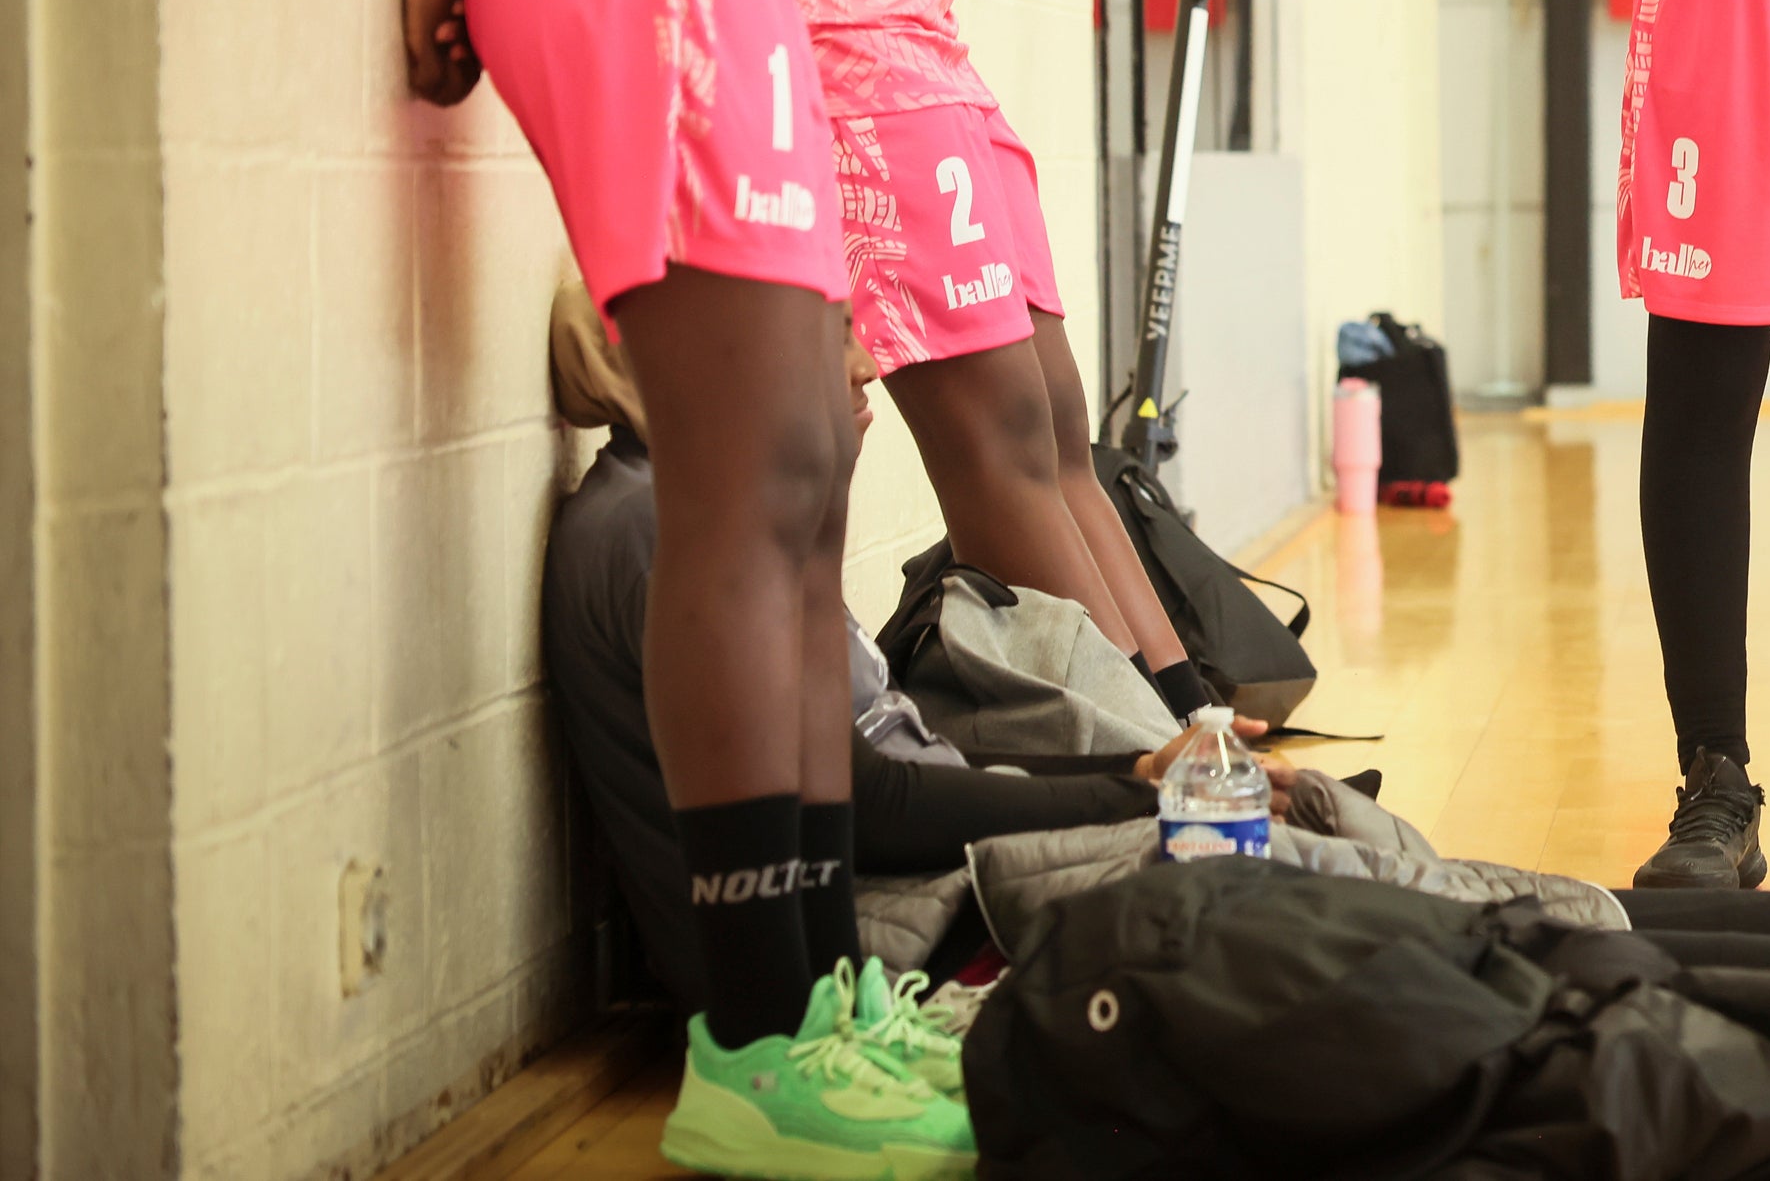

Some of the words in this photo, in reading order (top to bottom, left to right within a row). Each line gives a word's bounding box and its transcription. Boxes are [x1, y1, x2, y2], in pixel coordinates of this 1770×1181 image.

[768, 44, 794, 152] 1
[935, 156, 985, 247] 2
[1666, 137, 1699, 219] 3
[692, 858, 799, 905] NOLT
